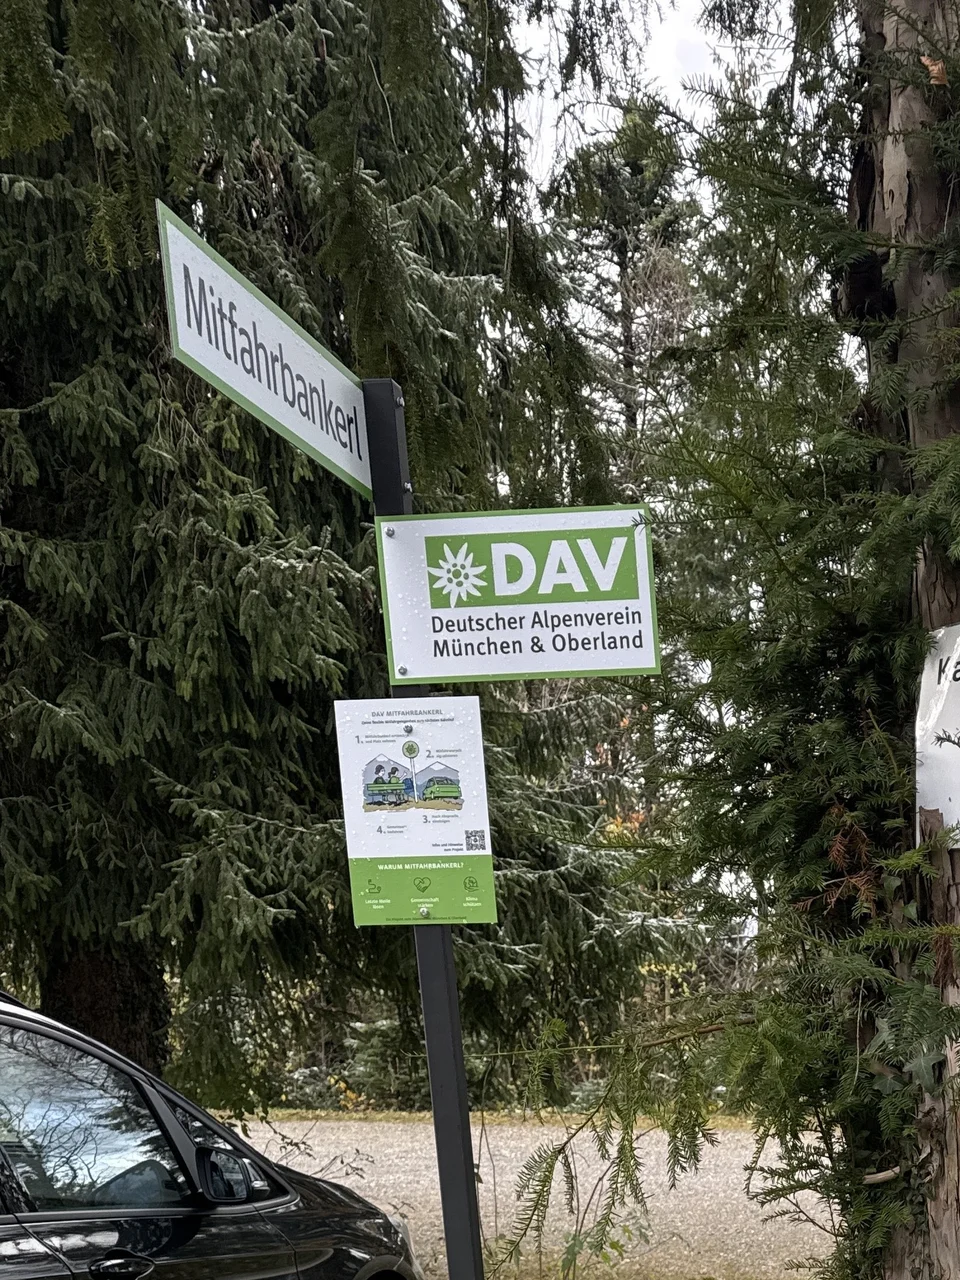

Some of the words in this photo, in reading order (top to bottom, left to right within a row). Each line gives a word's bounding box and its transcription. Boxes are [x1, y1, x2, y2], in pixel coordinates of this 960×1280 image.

[182, 263, 363, 462] Mitfahrbankerl
[491, 536, 628, 597] DAV
[431, 612, 526, 634] Deutscher
[531, 606, 642, 632] Alpenverein
[433, 637, 523, 658] München
[530, 635, 546, 653] &
[552, 630, 644, 652] Oberland
